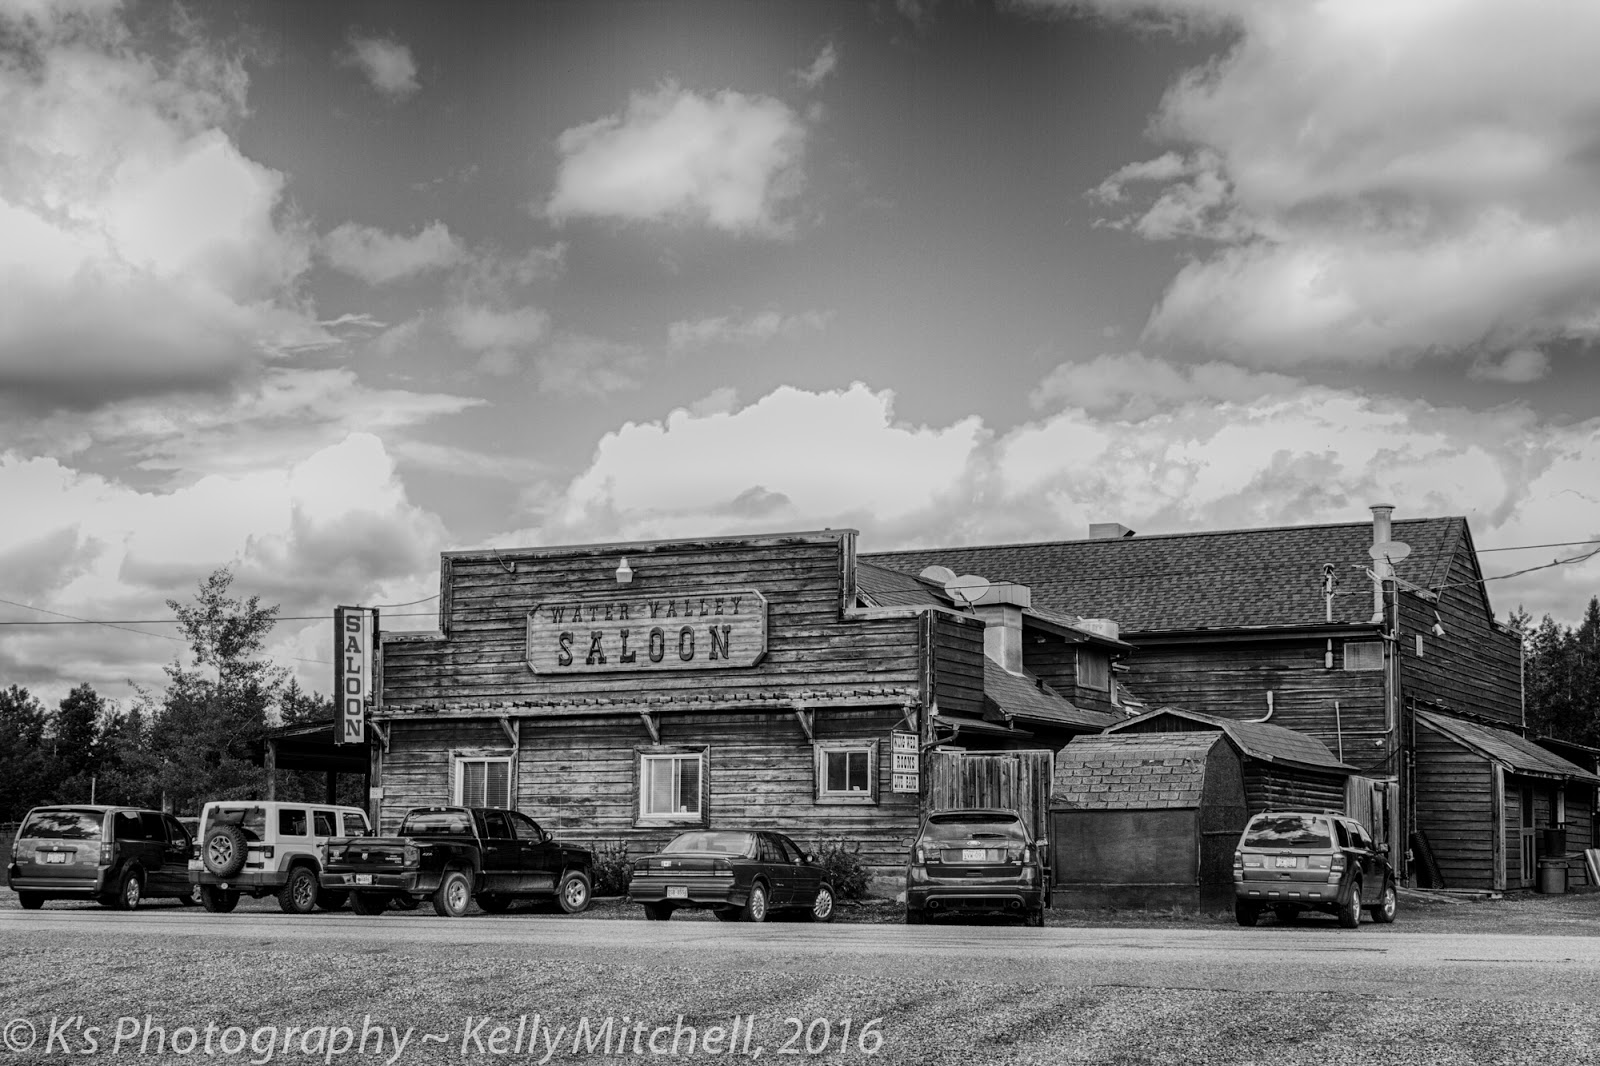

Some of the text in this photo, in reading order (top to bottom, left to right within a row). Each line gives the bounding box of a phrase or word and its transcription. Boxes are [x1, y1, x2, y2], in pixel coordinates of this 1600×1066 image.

[551, 596, 743, 624] WATER VALLEY
[558, 624, 732, 667] SALOON
[345, 615, 362, 737] SALOON
